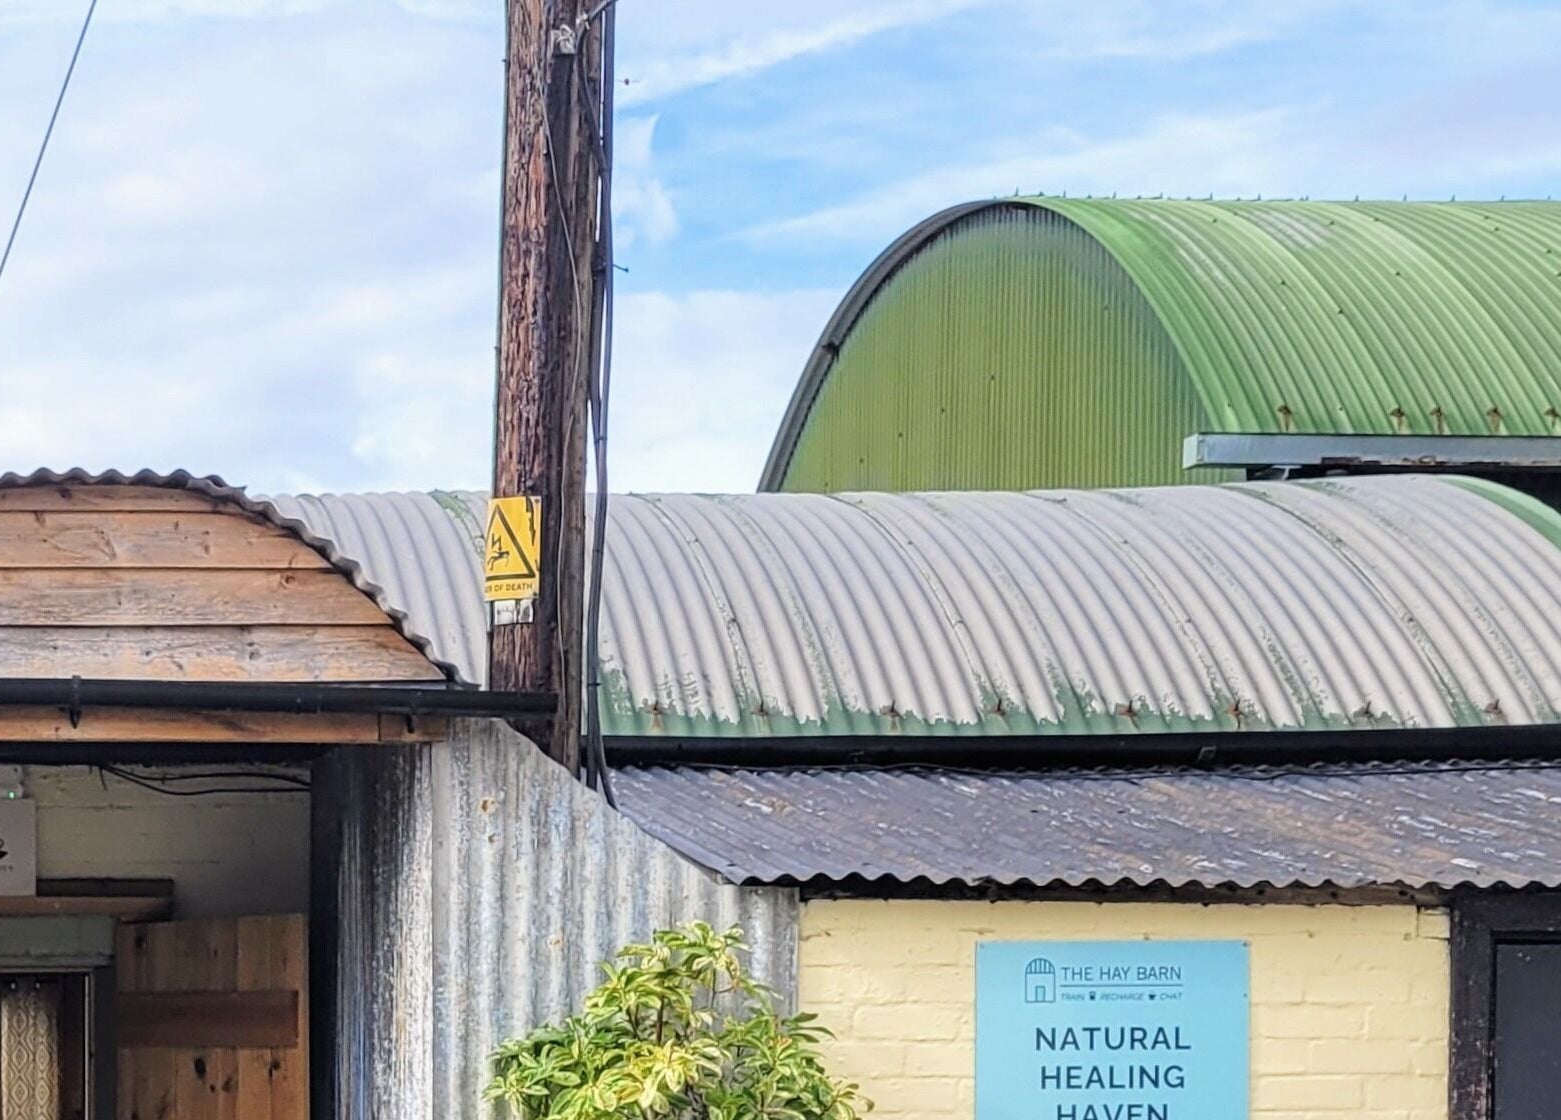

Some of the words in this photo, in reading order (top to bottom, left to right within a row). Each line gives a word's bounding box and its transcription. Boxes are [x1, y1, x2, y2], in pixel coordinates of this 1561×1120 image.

[494, 584, 504, 592] OF
[506, 583, 533, 592] DEATH
[1060, 966, 1093, 981] THE
[1100, 966, 1131, 981] HAY
[1137, 966, 1181, 981] BARN
[1061, 992, 1085, 1001] TRAIN
[1100, 992, 1144, 1001] RECHARGE
[1160, 992, 1183, 1001] CHAT
[1035, 1027, 1191, 1051] NATURAL
[1040, 1065, 1185, 1089] HEALING
